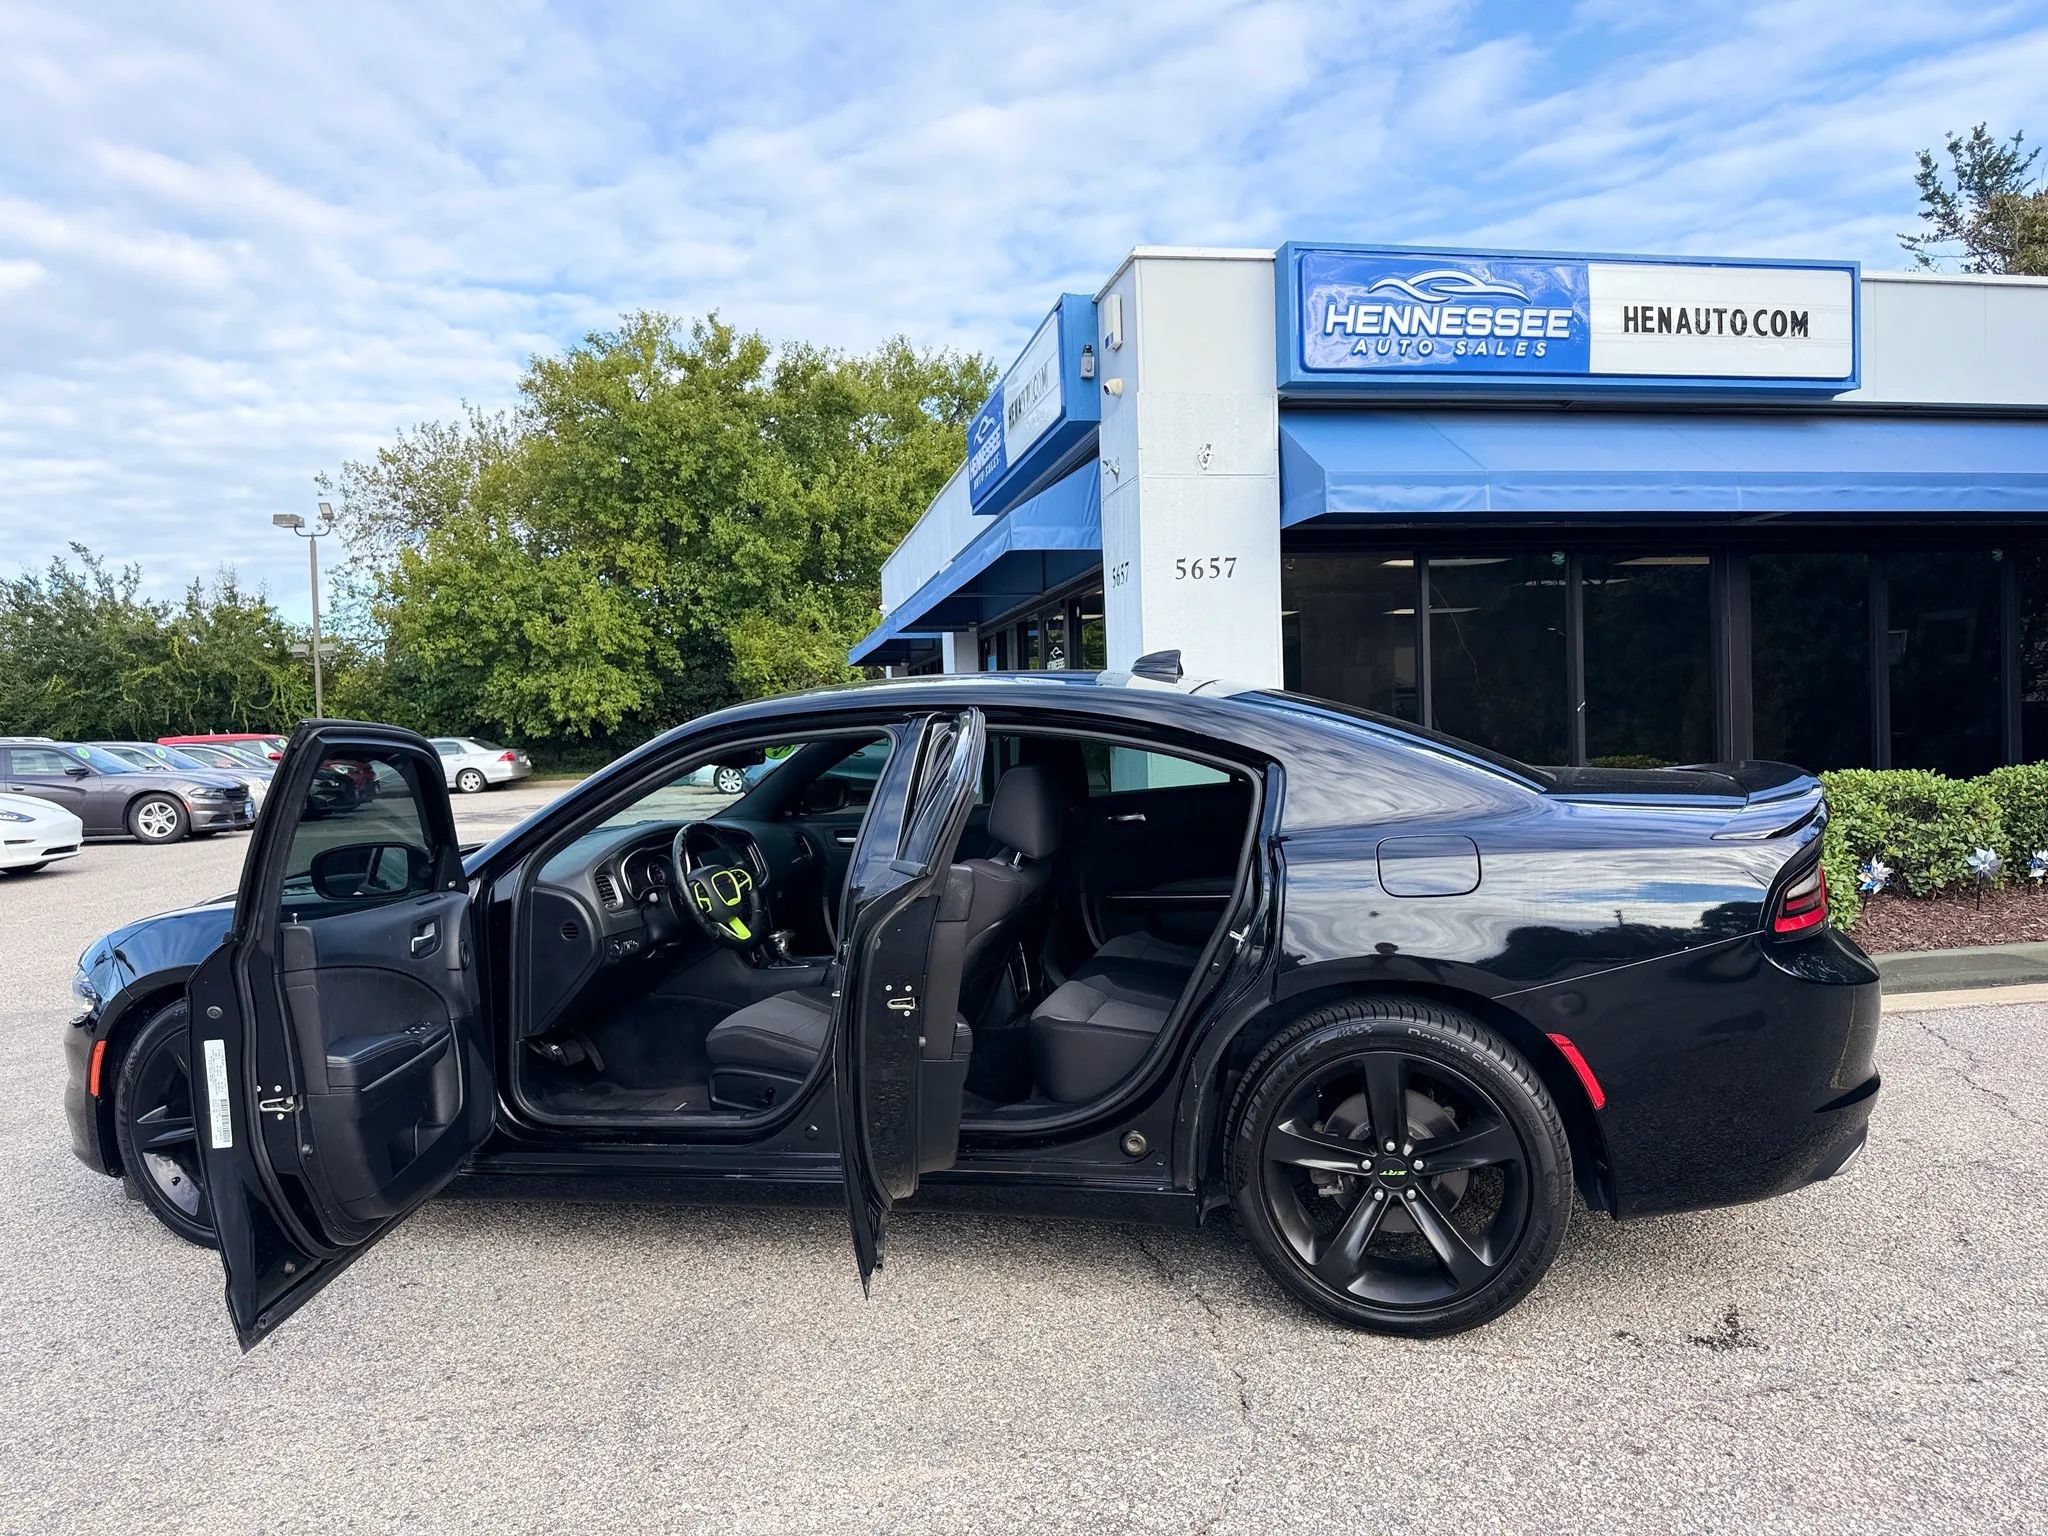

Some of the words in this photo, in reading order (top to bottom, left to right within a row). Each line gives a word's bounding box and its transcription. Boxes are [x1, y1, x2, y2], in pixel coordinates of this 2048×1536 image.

[1324, 303, 1574, 338] HENNESSEE
[1623, 305, 1810, 338] HENAUTO.COM
[1352, 338, 1435, 357] AUTO
[1454, 341, 1548, 358] SALES
[1112, 561, 1130, 588] 5657
[1175, 557, 1237, 580] 5657
